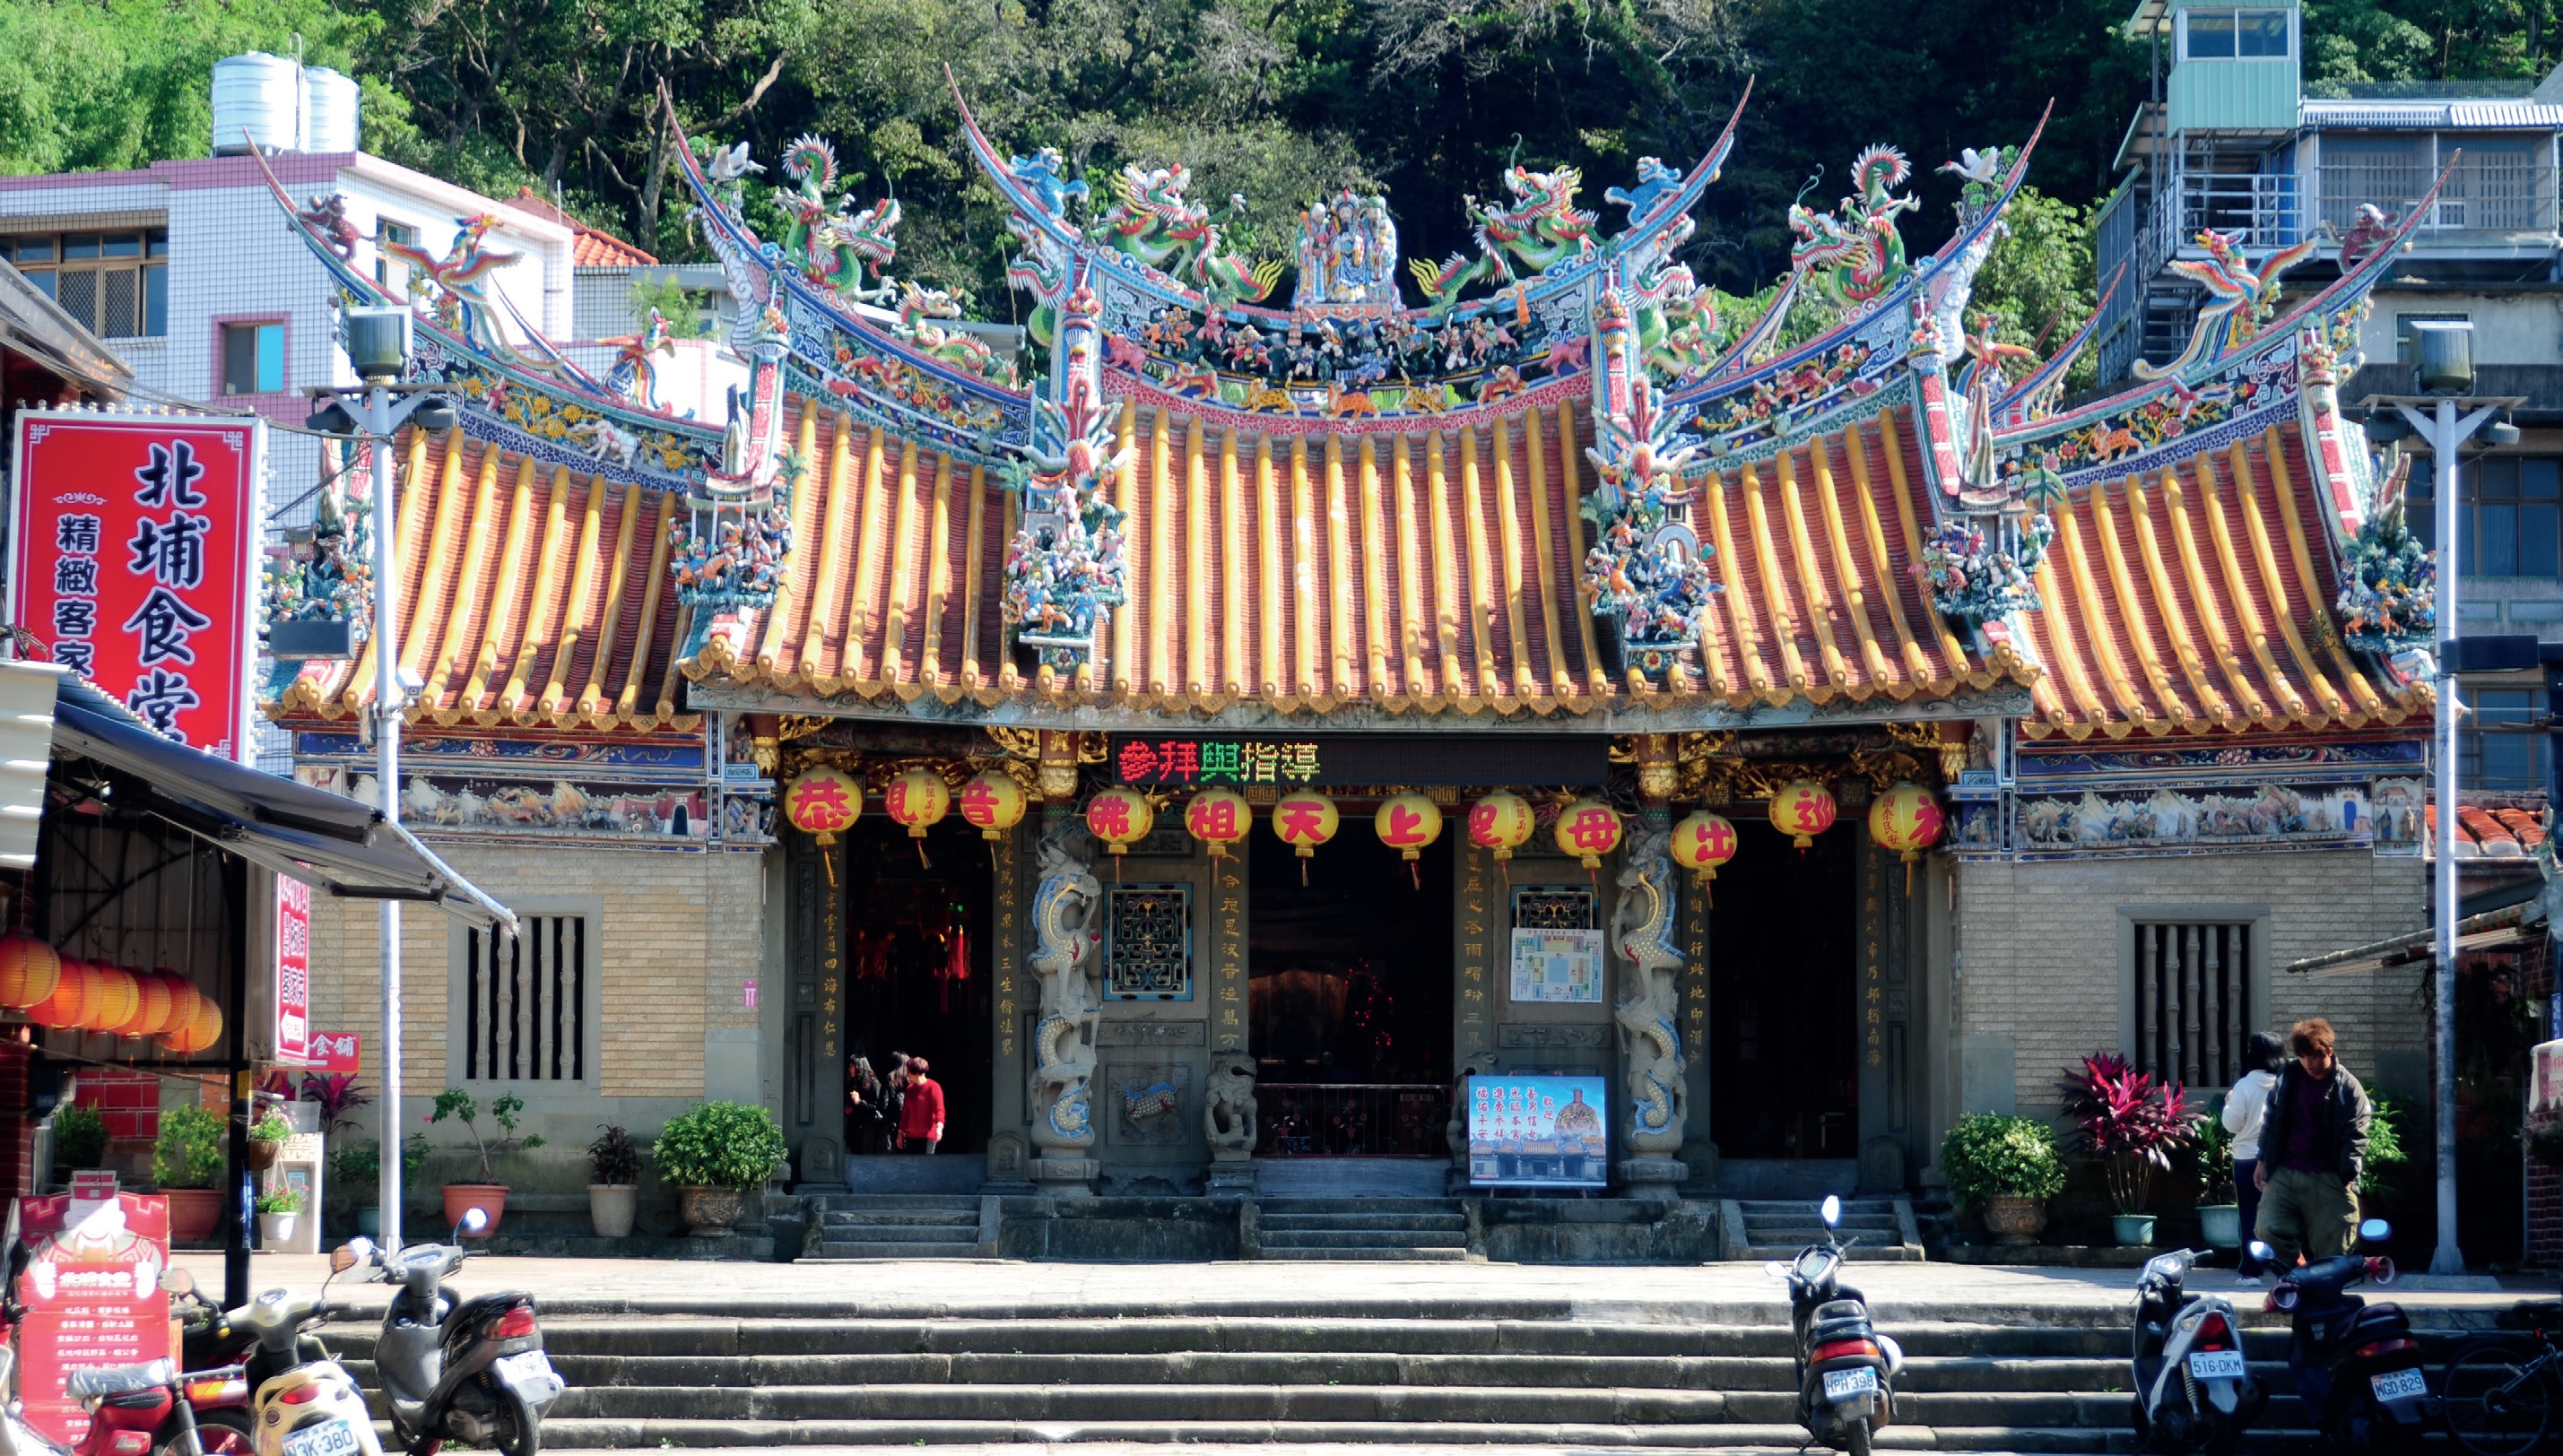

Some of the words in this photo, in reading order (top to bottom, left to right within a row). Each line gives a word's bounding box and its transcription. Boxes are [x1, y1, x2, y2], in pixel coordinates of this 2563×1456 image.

[52, 514, 100, 675] 精緻客家
[124, 440, 211, 744] 北埔食堂
[792, 776, 852, 830] 恭
[960, 778, 1000, 825] 音
[1086, 795, 1131, 838] 佛
[1189, 796, 1239, 839] 祖
[1282, 801, 1327, 842] 天
[1793, 789, 1837, 833] 巡
[1381, 803, 1427, 845] 上
[1567, 809, 1618, 852] 母
[1696, 820, 1733, 862] 出
[1510, 1087, 1522, 1140] 光臨本宮
[1526, 1087, 1538, 1140] 善男信女
